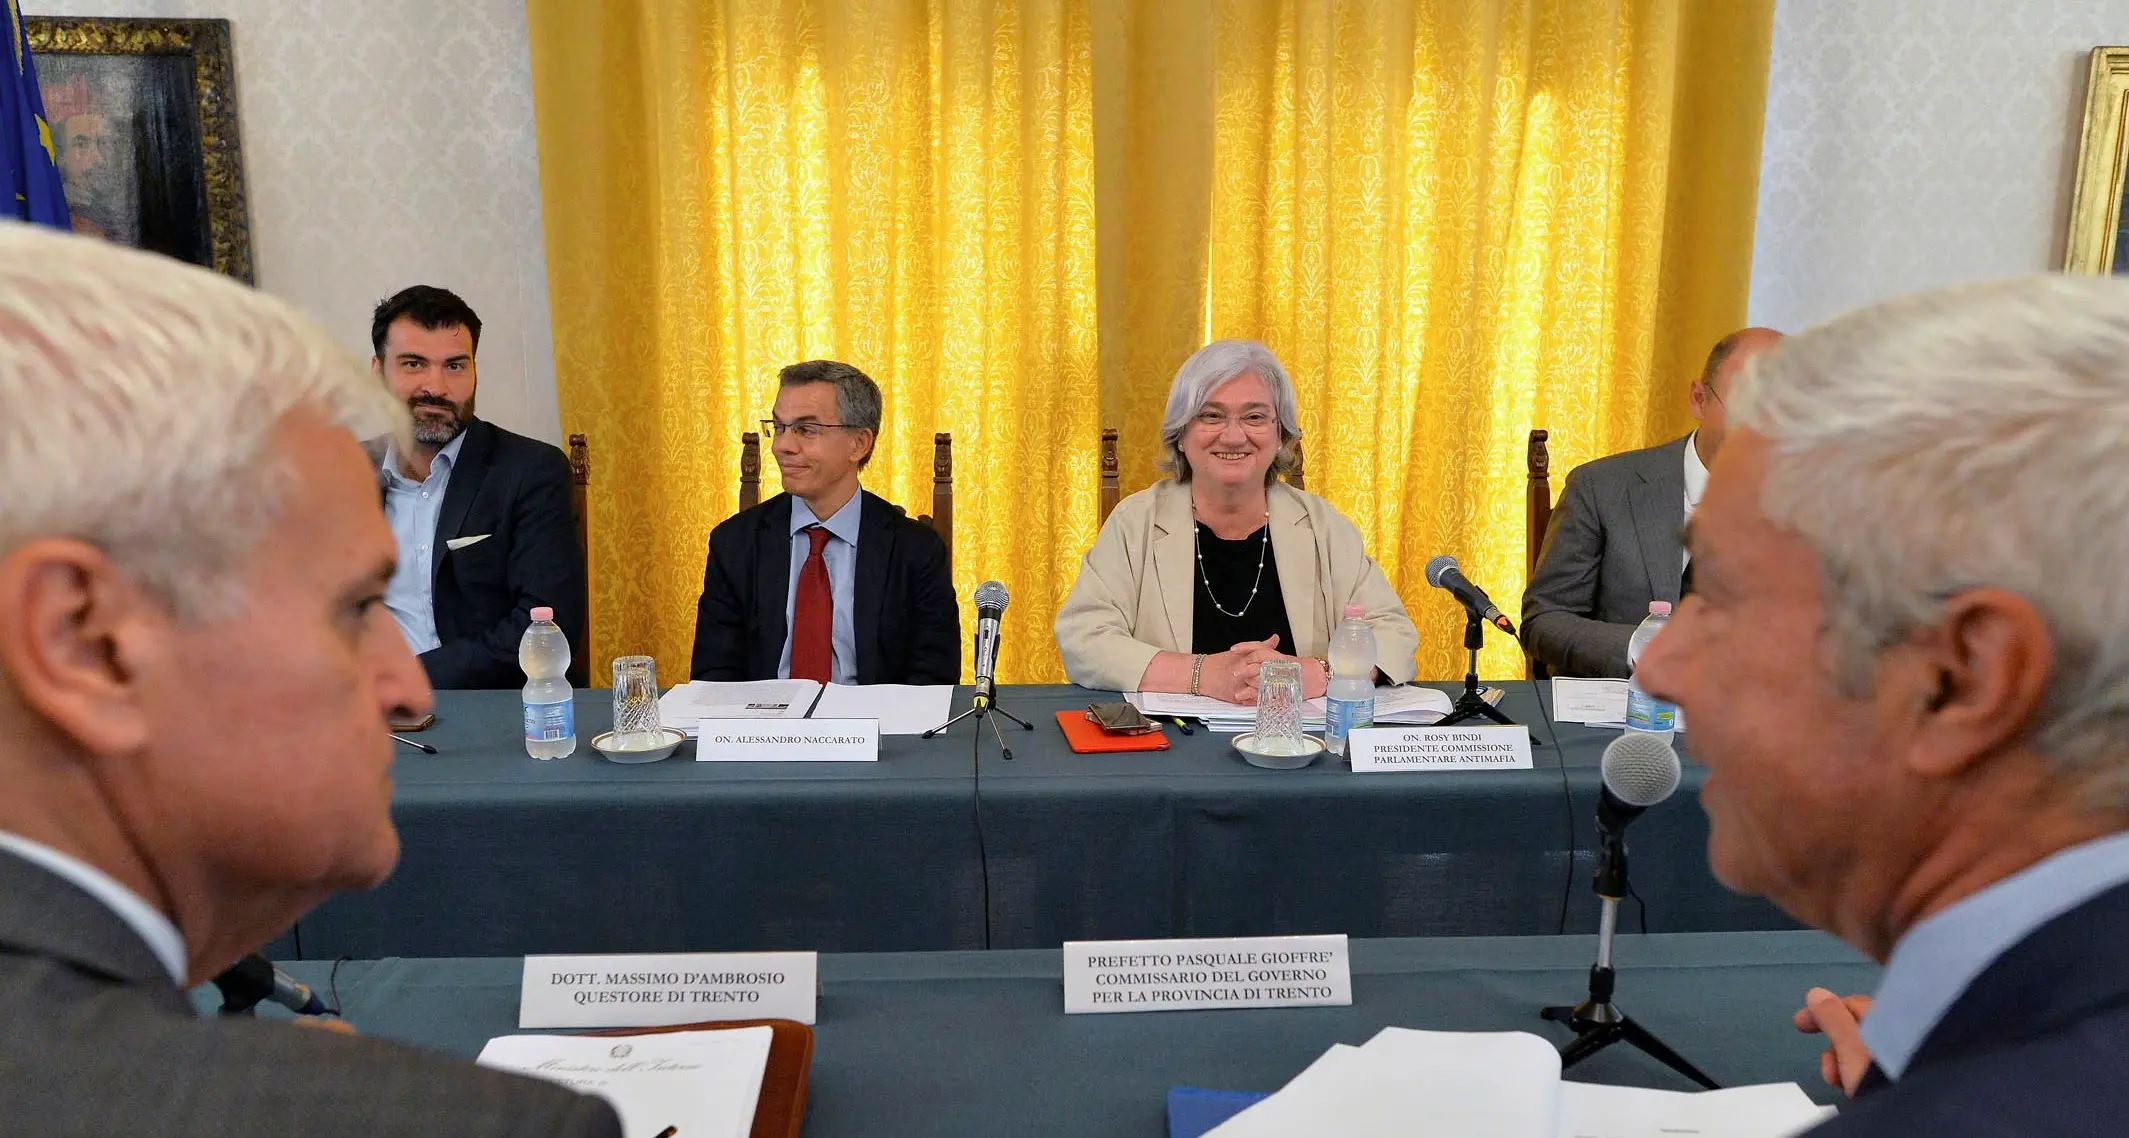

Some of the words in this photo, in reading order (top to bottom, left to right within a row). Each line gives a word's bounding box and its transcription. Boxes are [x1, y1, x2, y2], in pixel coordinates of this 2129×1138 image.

[715, 736, 734, 744] ON.
[736, 736, 801, 744] ALESSANDRO
[804, 736, 866, 744] NACCARATO
[1403, 734, 1422, 742] ON.
[1424, 734, 1450, 742] ROSY
[1453, 733, 1482, 741] BINDI
[1374, 745, 1439, 753] PRESIDENTE
[1441, 744, 1513, 752] COMMISSIONE
[1374, 756, 1457, 764] PARLAMENTARE
[1459, 755, 1516, 763] ANTIMAFIA
[1088, 954, 1172, 968] PREFETTO
[1176, 952, 1257, 968] PASQUALE
[1261, 951, 1333, 964] GIOFFRE'
[551, 972, 601, 985] DOTT.
[605, 972, 679, 985] MASSIMO
[683, 971, 785, 985] D'AMBROSIO
[1096, 970, 1208, 986] COMMISSARIO
[1212, 971, 1244, 983] DEL
[1248, 968, 1327, 982] GOVERNO
[574, 990, 664, 1005] QUESTORE
[667, 990, 685, 1003] DI
[690, 989, 760, 1003] TRENTO
[1093, 990, 1124, 1003] PER
[1128, 990, 1148, 1002] LA
[1151, 988, 1239, 1002] PROVINCIA
[1244, 988, 1261, 1000] DI
[1264, 986, 1332, 999] TRENTO
